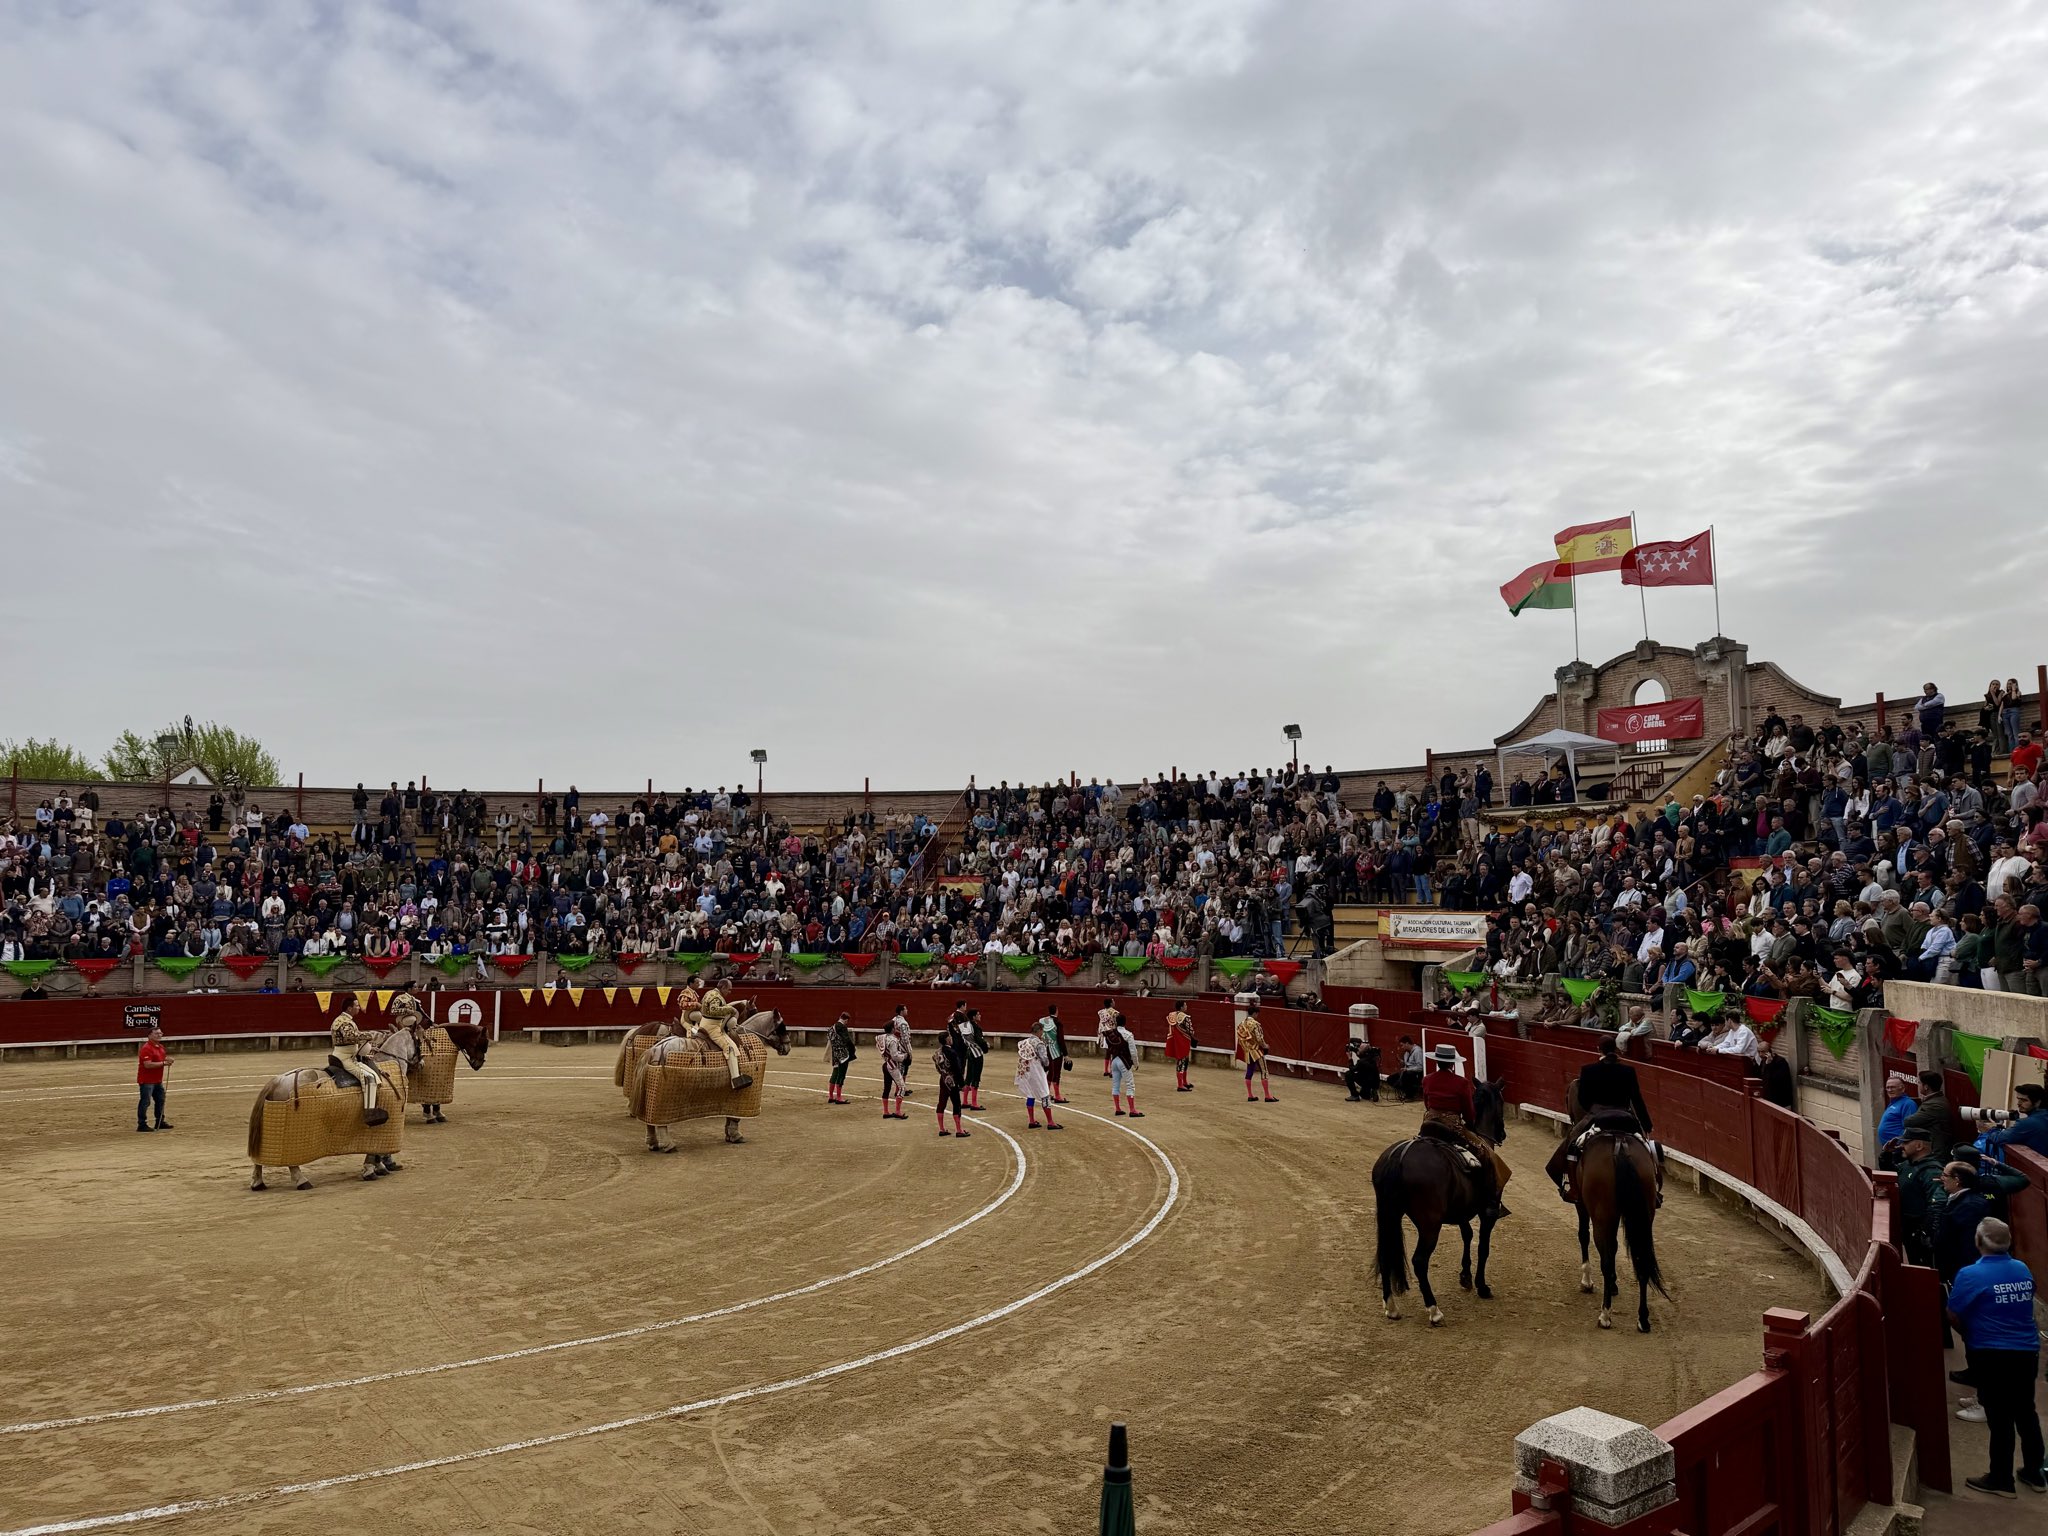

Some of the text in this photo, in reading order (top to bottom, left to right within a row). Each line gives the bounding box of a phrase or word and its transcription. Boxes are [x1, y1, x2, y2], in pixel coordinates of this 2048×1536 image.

[1403, 926, 1437, 934] MIRAFLORES
[207, 973, 216, 984] 6
[124, 1005, 161, 1013] Camisas
[1890, 1070, 1919, 1085] ENFERMER
[1993, 1281, 2033, 1293] SERVICIO
[1995, 1295, 2008, 1303] DE
